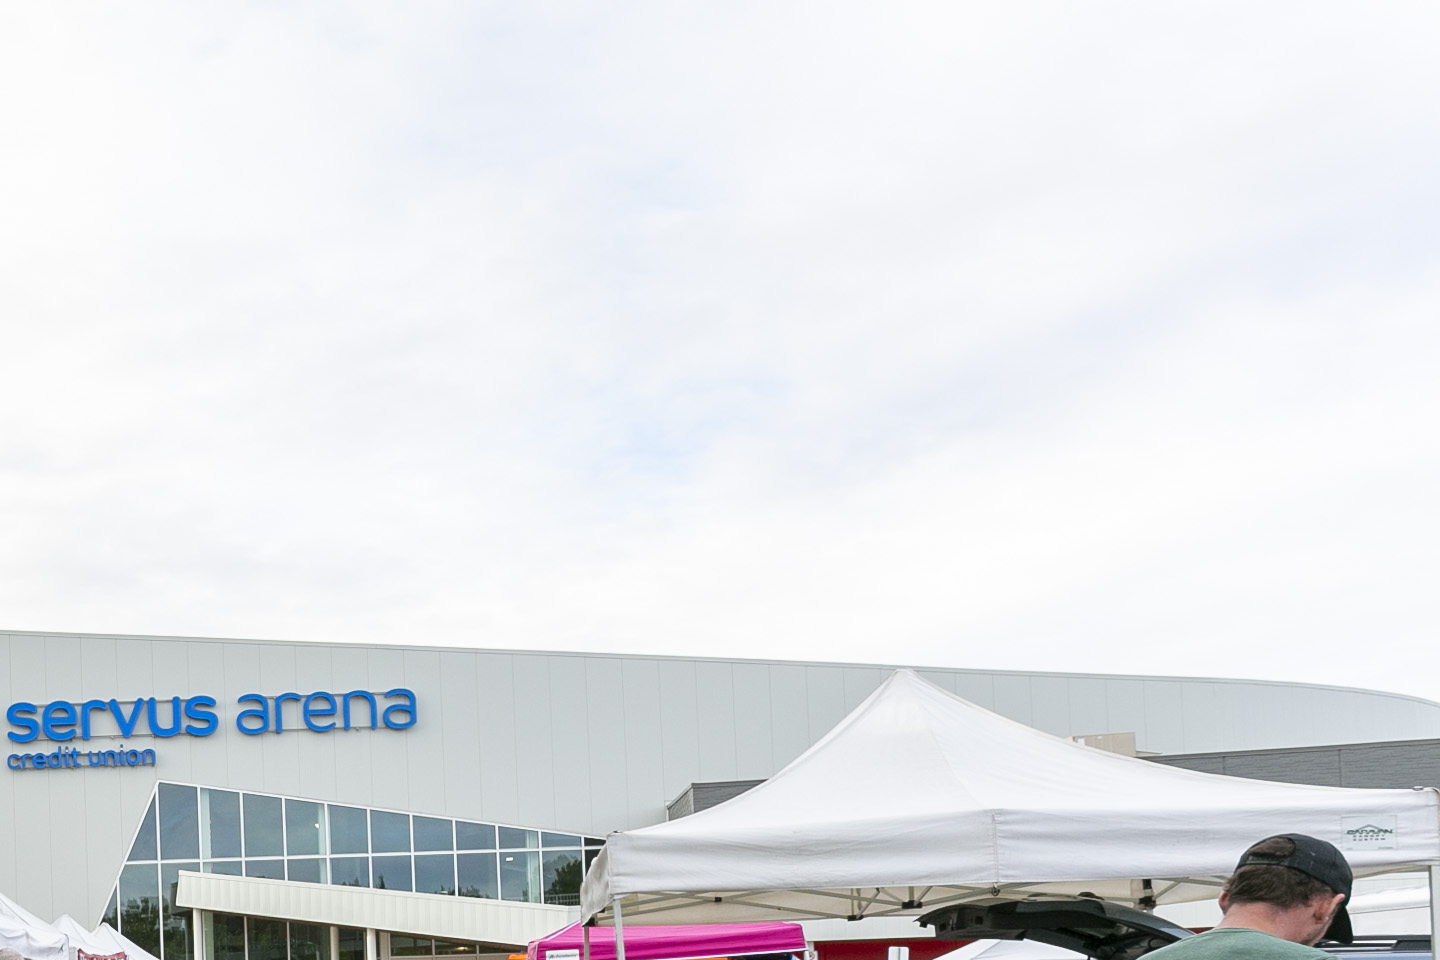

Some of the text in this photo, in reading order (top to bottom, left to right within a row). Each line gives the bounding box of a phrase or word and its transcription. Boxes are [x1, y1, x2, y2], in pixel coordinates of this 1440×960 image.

[6, 688, 418, 743] servus arena
[7, 744, 157, 770] credit union
